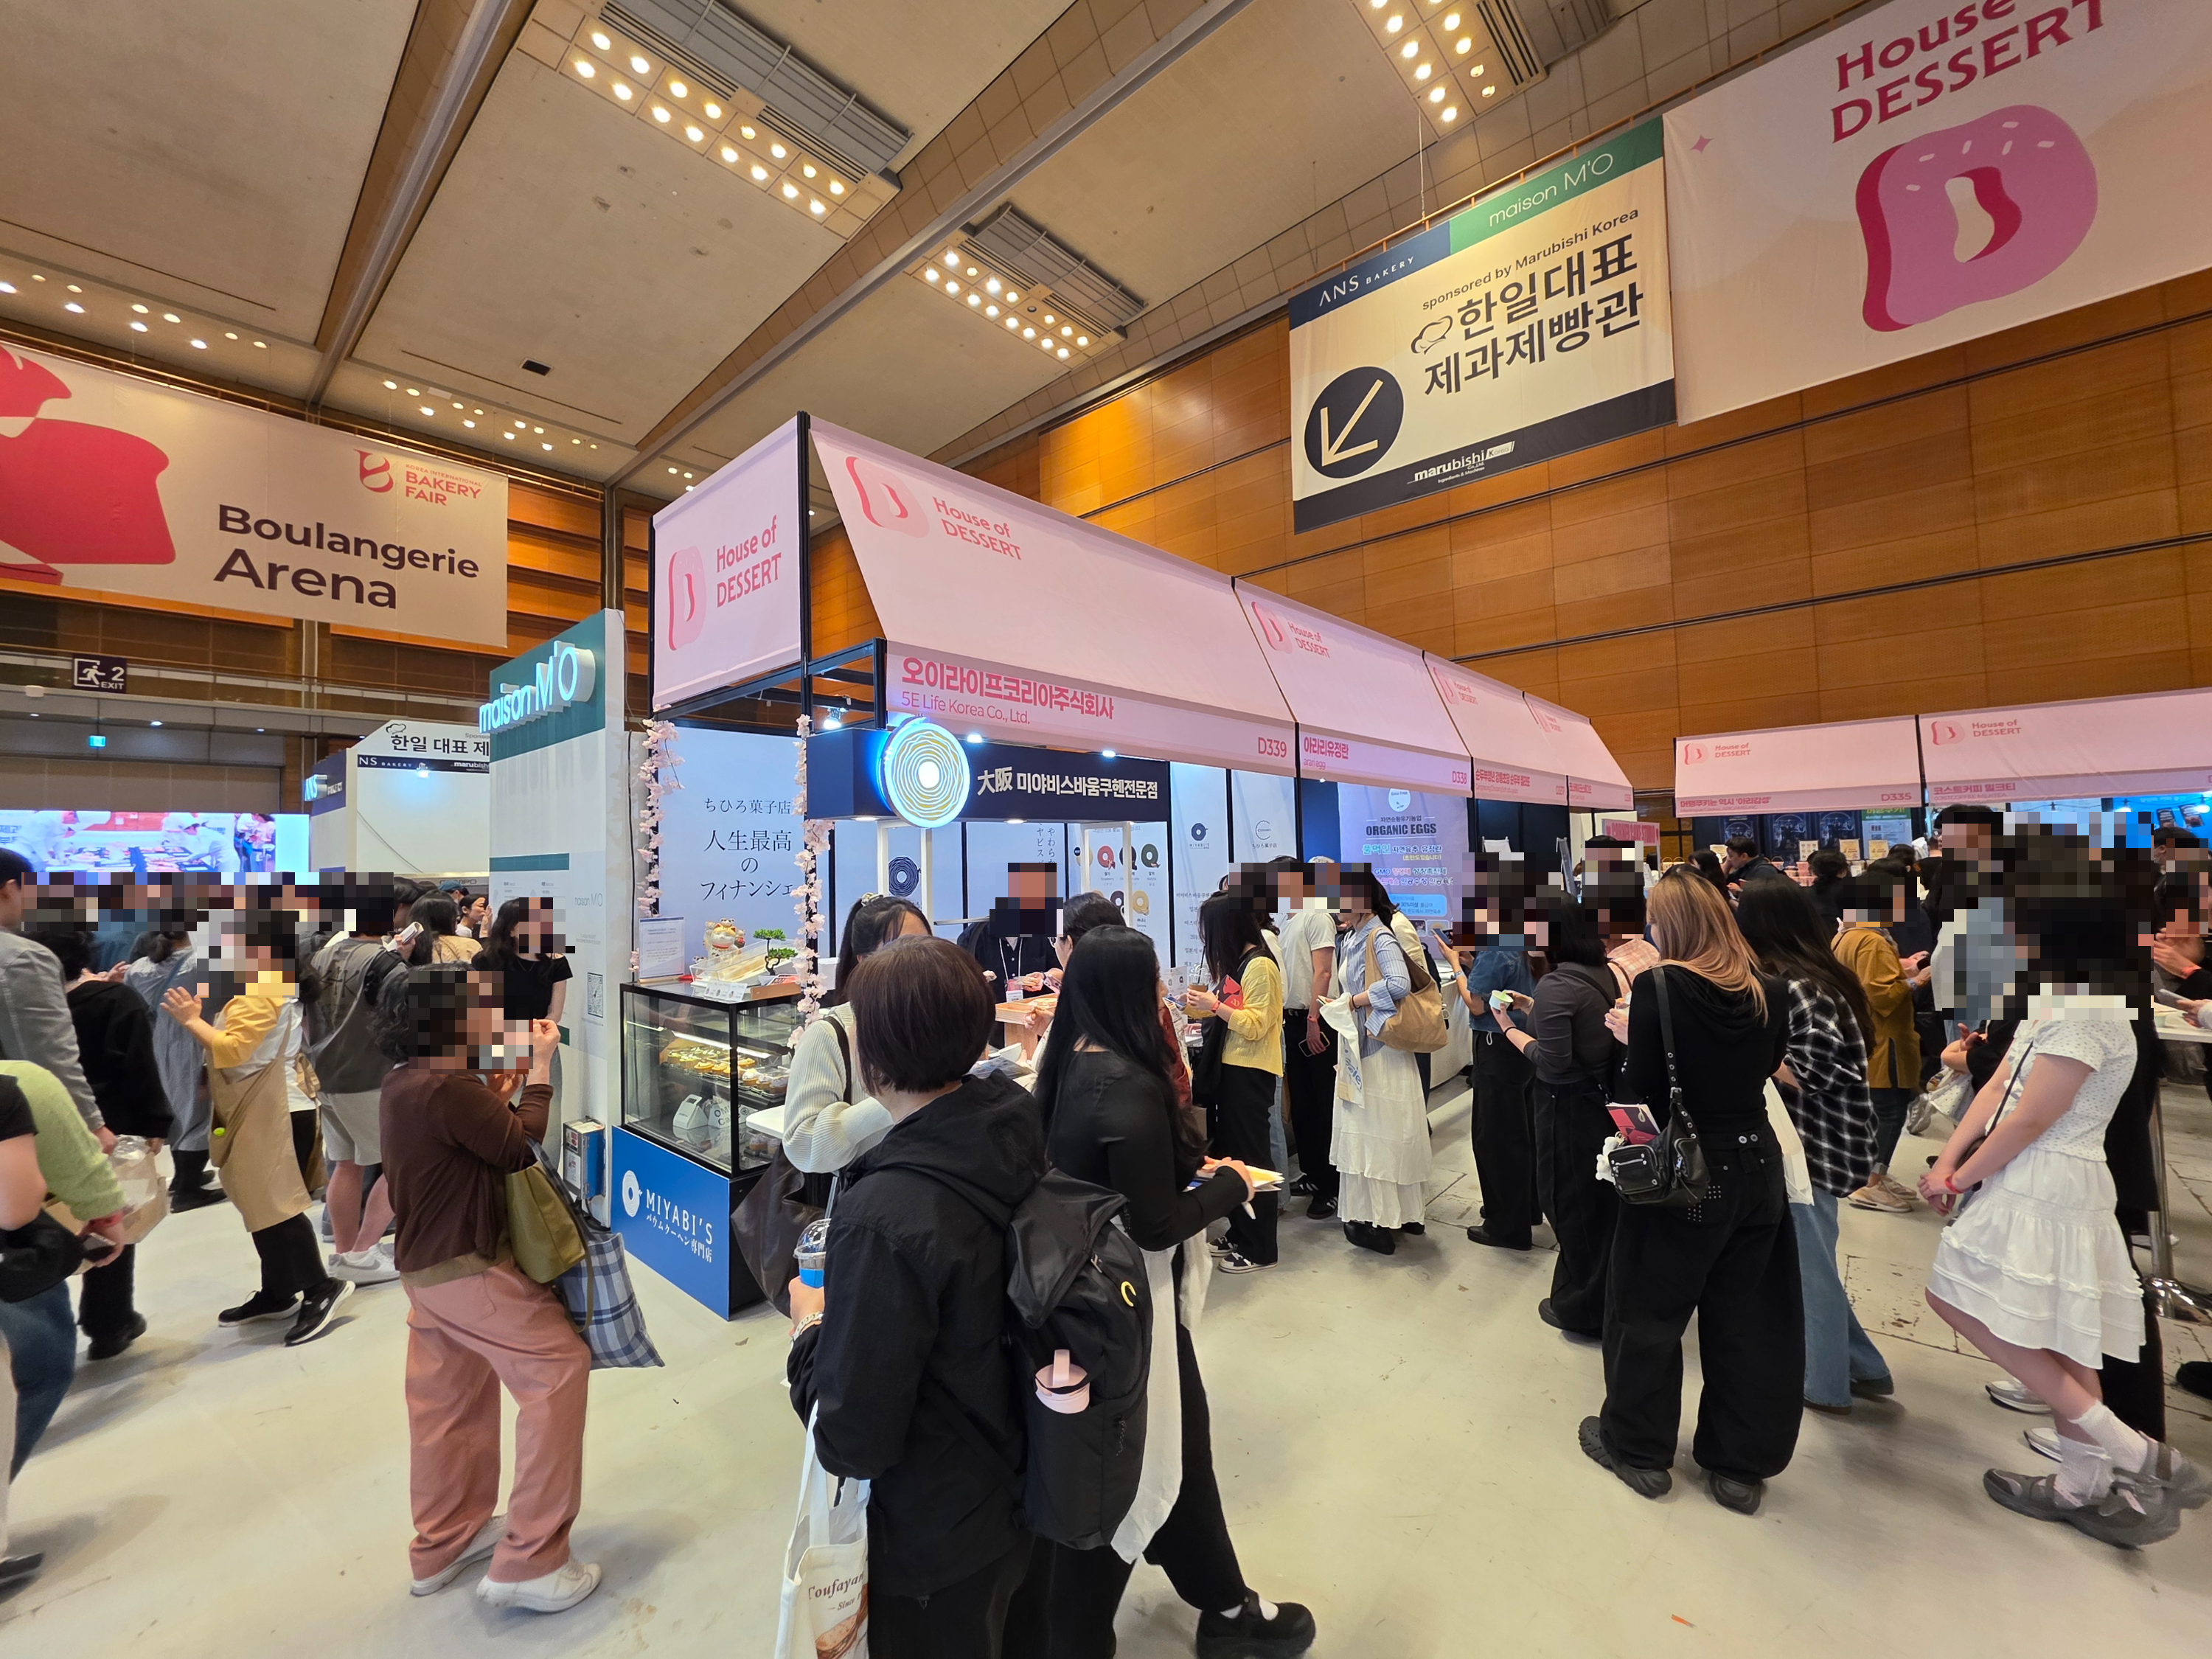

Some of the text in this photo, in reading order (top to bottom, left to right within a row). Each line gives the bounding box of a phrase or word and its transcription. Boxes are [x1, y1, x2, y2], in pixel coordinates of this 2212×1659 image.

[1830, 0, 2104, 144] DESSERT
[1488, 184, 1557, 227] maison
[1422, 209, 1639, 312] sponsored by Marubishi Korea
[1318, 255, 1416, 307] ANS BAKERY
[1457, 233, 1638, 341] 한일대표
[1424, 282, 1644, 396] 제과제빵관
[406, 464, 482, 487] KOREA INTERNATIONAL
[1414, 449, 1485, 481] marubishi
[406, 470, 481, 499] BAKERY
[406, 485, 447, 506] FAIR
[931, 495, 1011, 538] House of
[218, 503, 480, 580] Boulangerie
[716, 515, 777, 573] House of
[941, 518, 1022, 560] DESSERT
[214, 547, 397, 610] Arena
[716, 552, 782, 608] DESSERT
[1287, 621, 1323, 644] House of
[1294, 636, 1330, 658] DESSERT
[111, 666, 125, 681] 2
[100, 681, 124, 691] EXIT
[901, 655, 1115, 720] 오이라이프코리아주식회사
[479, 684, 532, 734] maison
[902, 691, 919, 708] 5E
[922, 692, 946, 712] Life
[948, 697, 984, 717] Korea
[1010, 706, 1031, 725] Ltd.
[1972, 719, 2018, 731] House of
[1972, 726, 2023, 738] DESSERT
[391, 734, 428, 753] 한일
[434, 737, 468, 754] 대표
[1257, 737, 1288, 759] D339
[1304, 736, 1349, 760] 아라리유정란
[1714, 748, 1752, 759] DESSERT
[1715, 742, 1750, 752] House of
[1315, 760, 1326, 771] egg
[977, 766, 1158, 800] 大阪 미야비스바움쿠헨전문점
[1452, 771, 1467, 785] D338
[703, 798, 792, 815] ちひろ菓子店
[1719, 798, 1734, 806] 역시
[1881, 793, 1912, 802] D335
[703, 830, 793, 852] 人生最高
[1366, 823, 1437, 835] ORGANIC EGGS
[740, 857, 759, 874] の
[646, 1189, 713, 1245] MIYABI'S
[646, 1214, 713, 1263] バウムクーヘン専門店
